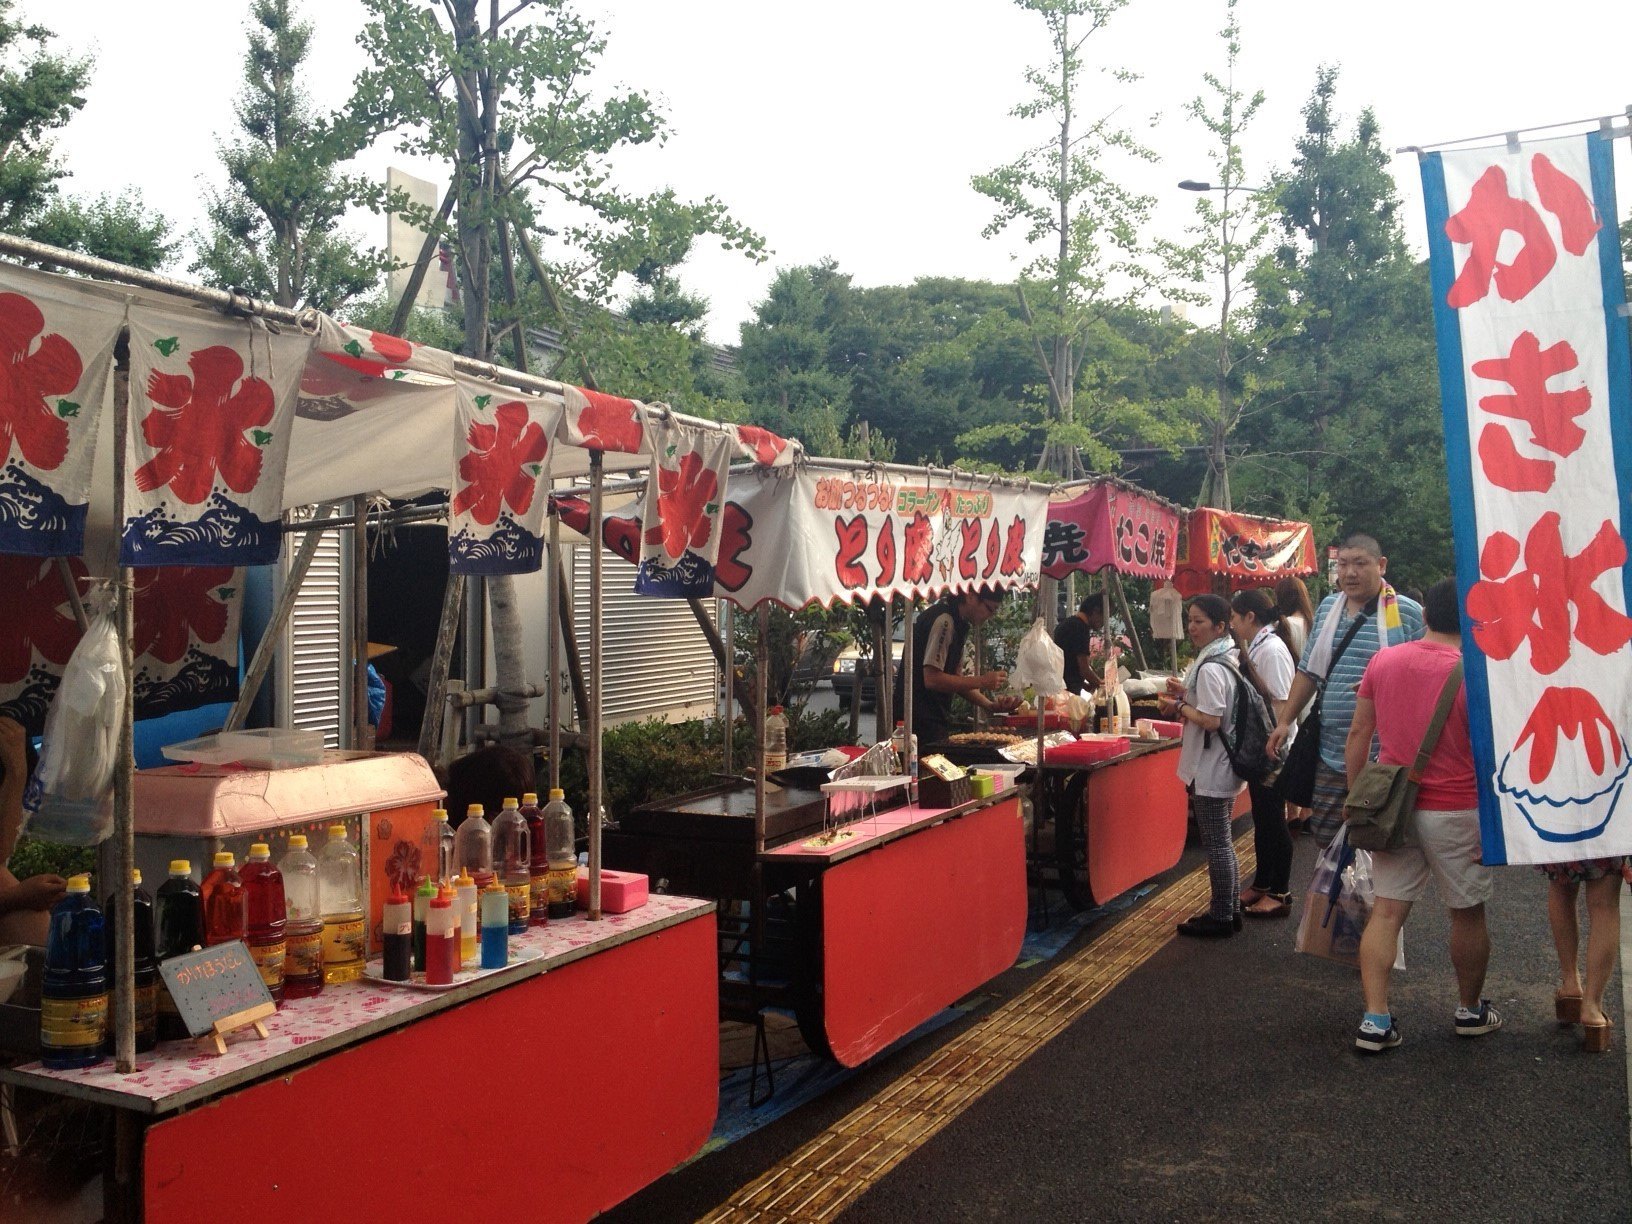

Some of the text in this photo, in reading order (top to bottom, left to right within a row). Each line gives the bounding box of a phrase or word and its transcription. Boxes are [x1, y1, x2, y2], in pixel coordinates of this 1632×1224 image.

[1445, 151, 1632, 676] かき氷
[896, 489, 992, 515] コラーゲン たっぷり
[834, 509, 934, 590] とり皮
[957, 513, 1027, 581] とり皮
[1115, 512, 1168, 569] たこ焼
